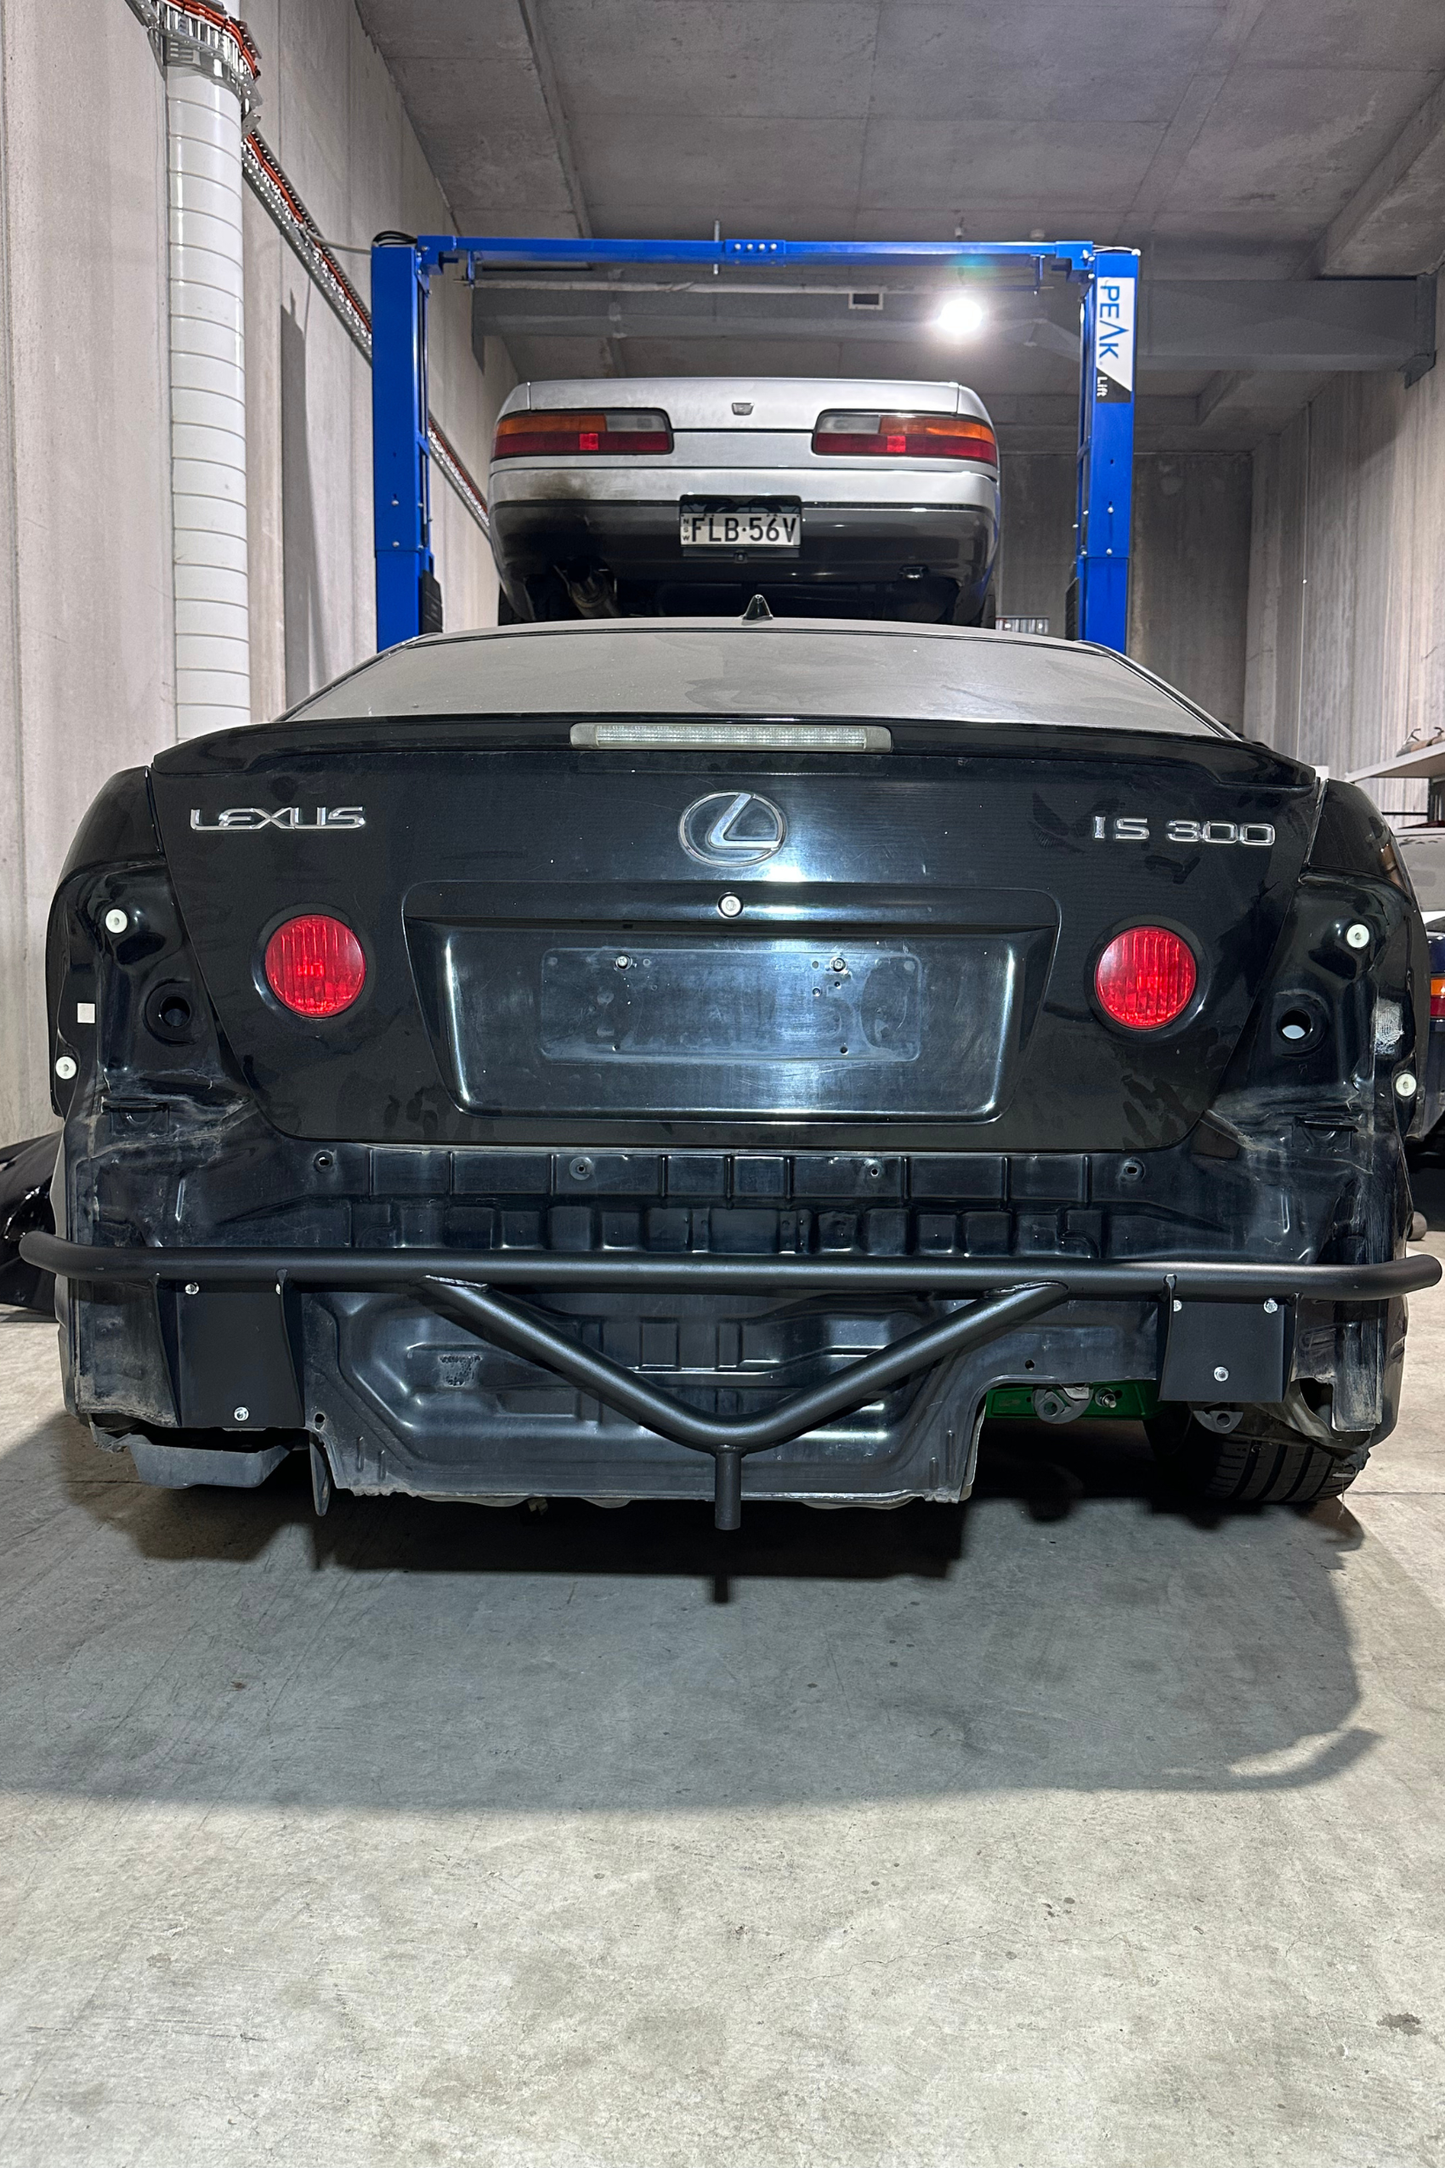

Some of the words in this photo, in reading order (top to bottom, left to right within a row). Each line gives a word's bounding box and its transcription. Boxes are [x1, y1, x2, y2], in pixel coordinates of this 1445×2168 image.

[1099, 285, 1129, 359] PEAK
[1096, 376, 1108, 397] Lift
[682, 518, 690, 541] NSW
[190, 806, 366, 831] LEXUS
[1165, 820, 1276, 846] 300
